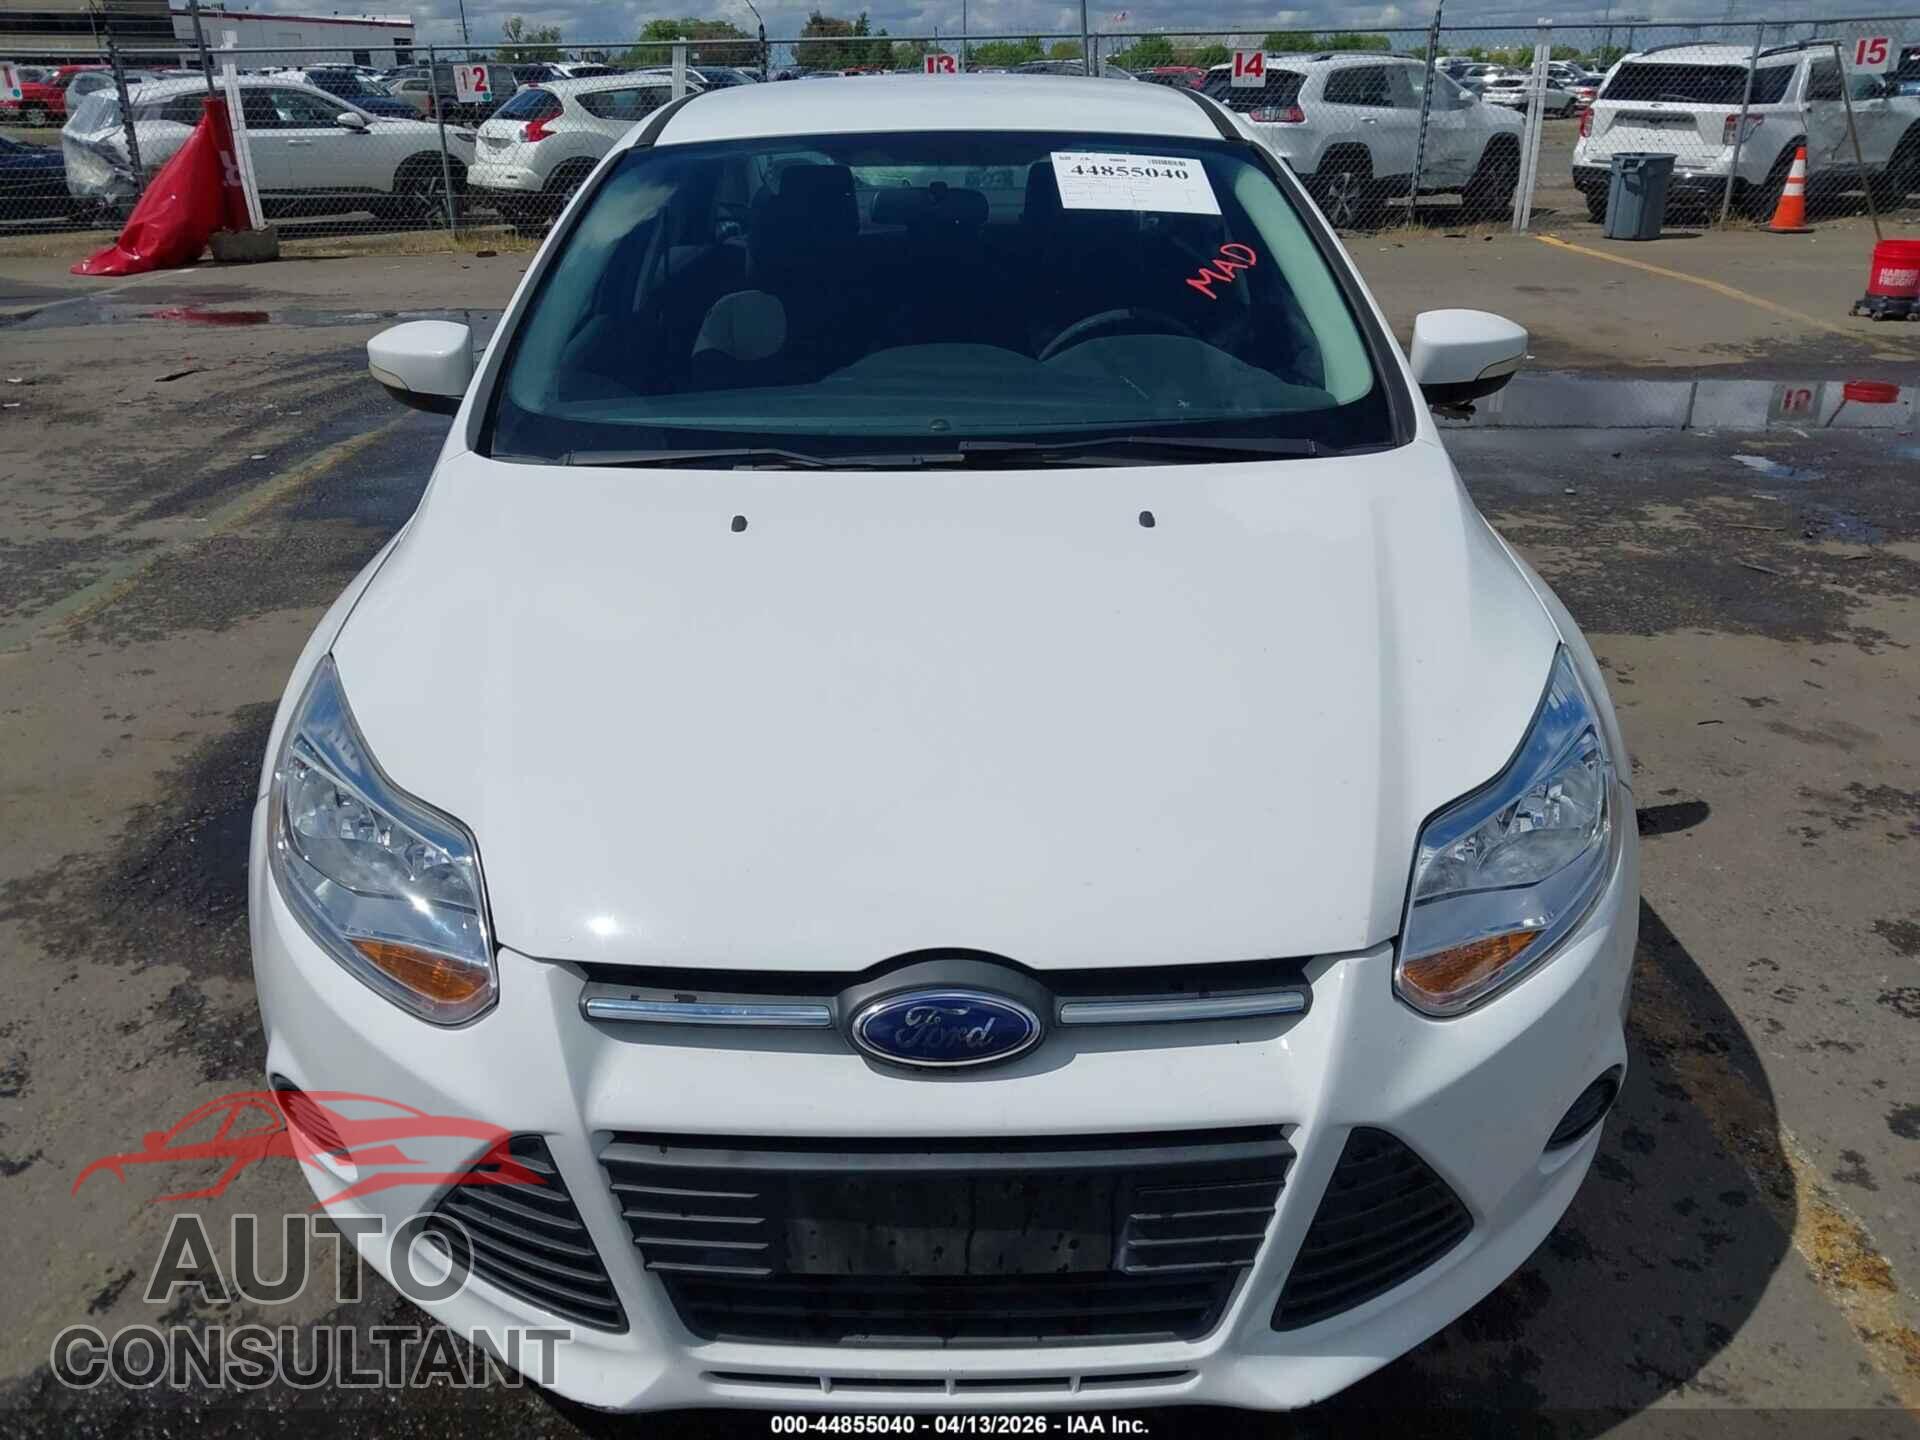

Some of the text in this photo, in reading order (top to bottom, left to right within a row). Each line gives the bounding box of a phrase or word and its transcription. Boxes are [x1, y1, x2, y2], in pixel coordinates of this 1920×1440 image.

[1235, 51, 1264, 77] 14
[1856, 38, 1888, 65] 15
[461, 66, 488, 92] 12
[1070, 164, 1189, 180] 44855040
[1186, 243, 1257, 299] MAD
[896, 1006, 996, 1048] Ford
